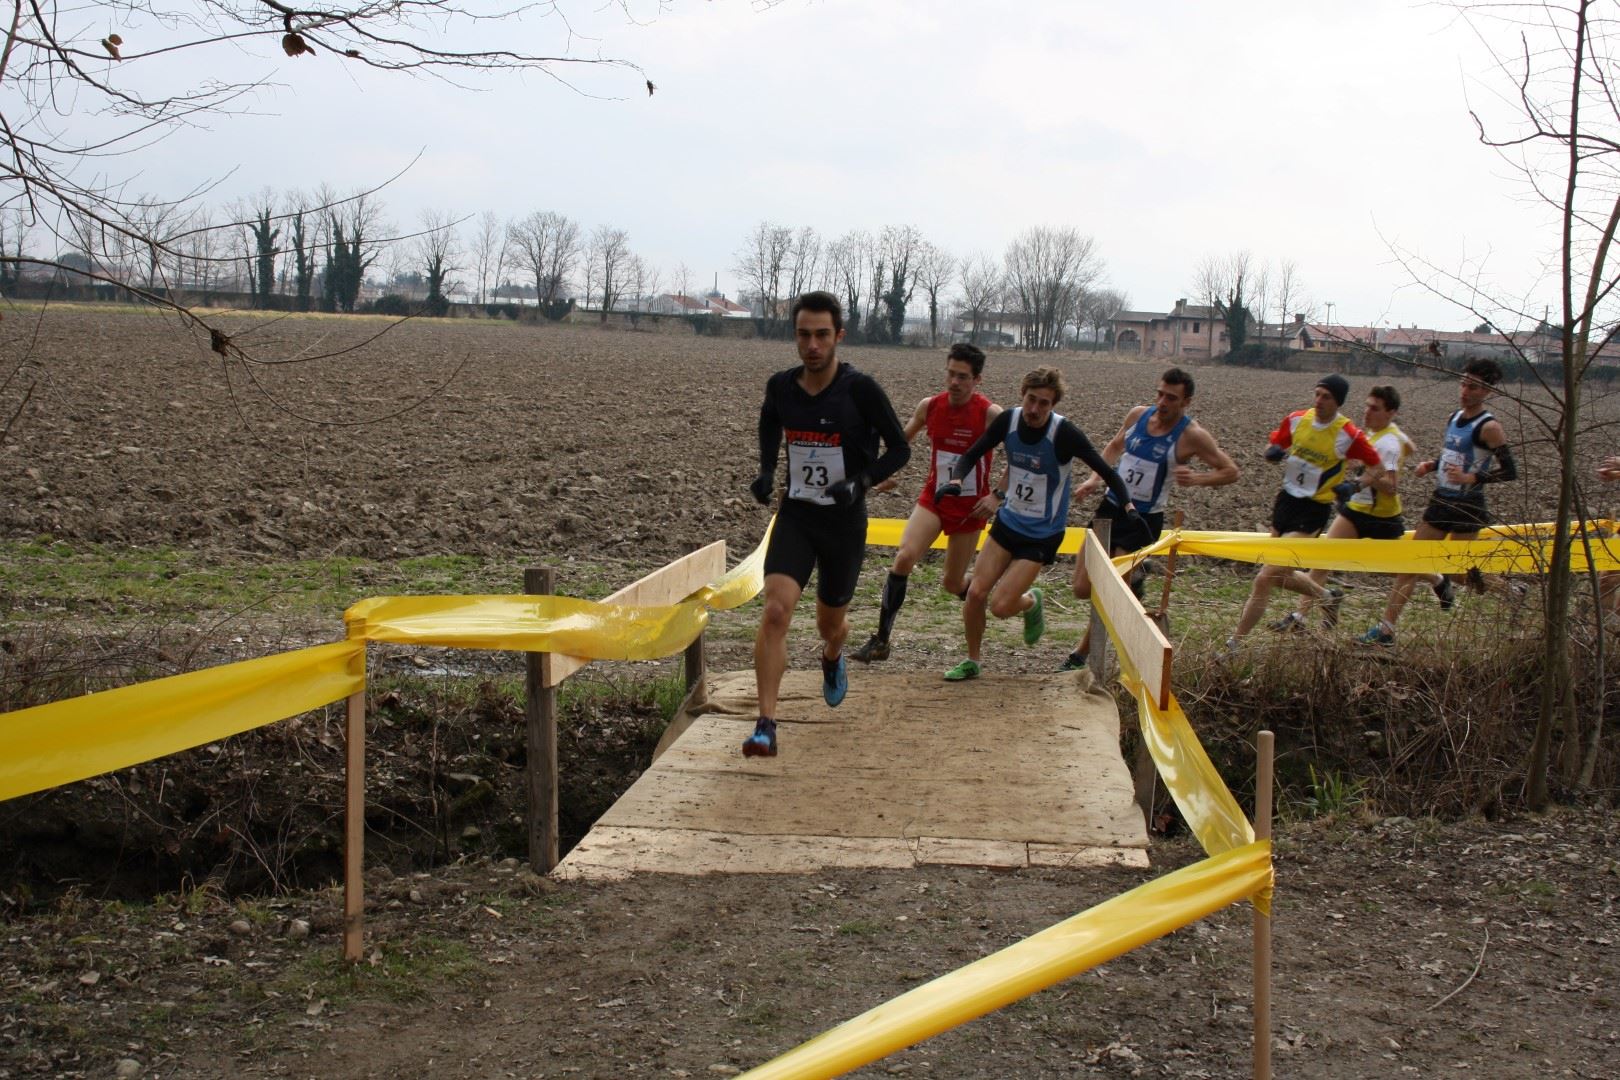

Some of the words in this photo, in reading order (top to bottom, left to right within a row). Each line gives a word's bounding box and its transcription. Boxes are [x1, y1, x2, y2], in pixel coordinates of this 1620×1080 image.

[802, 465, 829, 487] 23
[1125, 468, 1145, 487] 37
[1295, 472, 1305, 486] 4
[1015, 483, 1034, 502] 42
